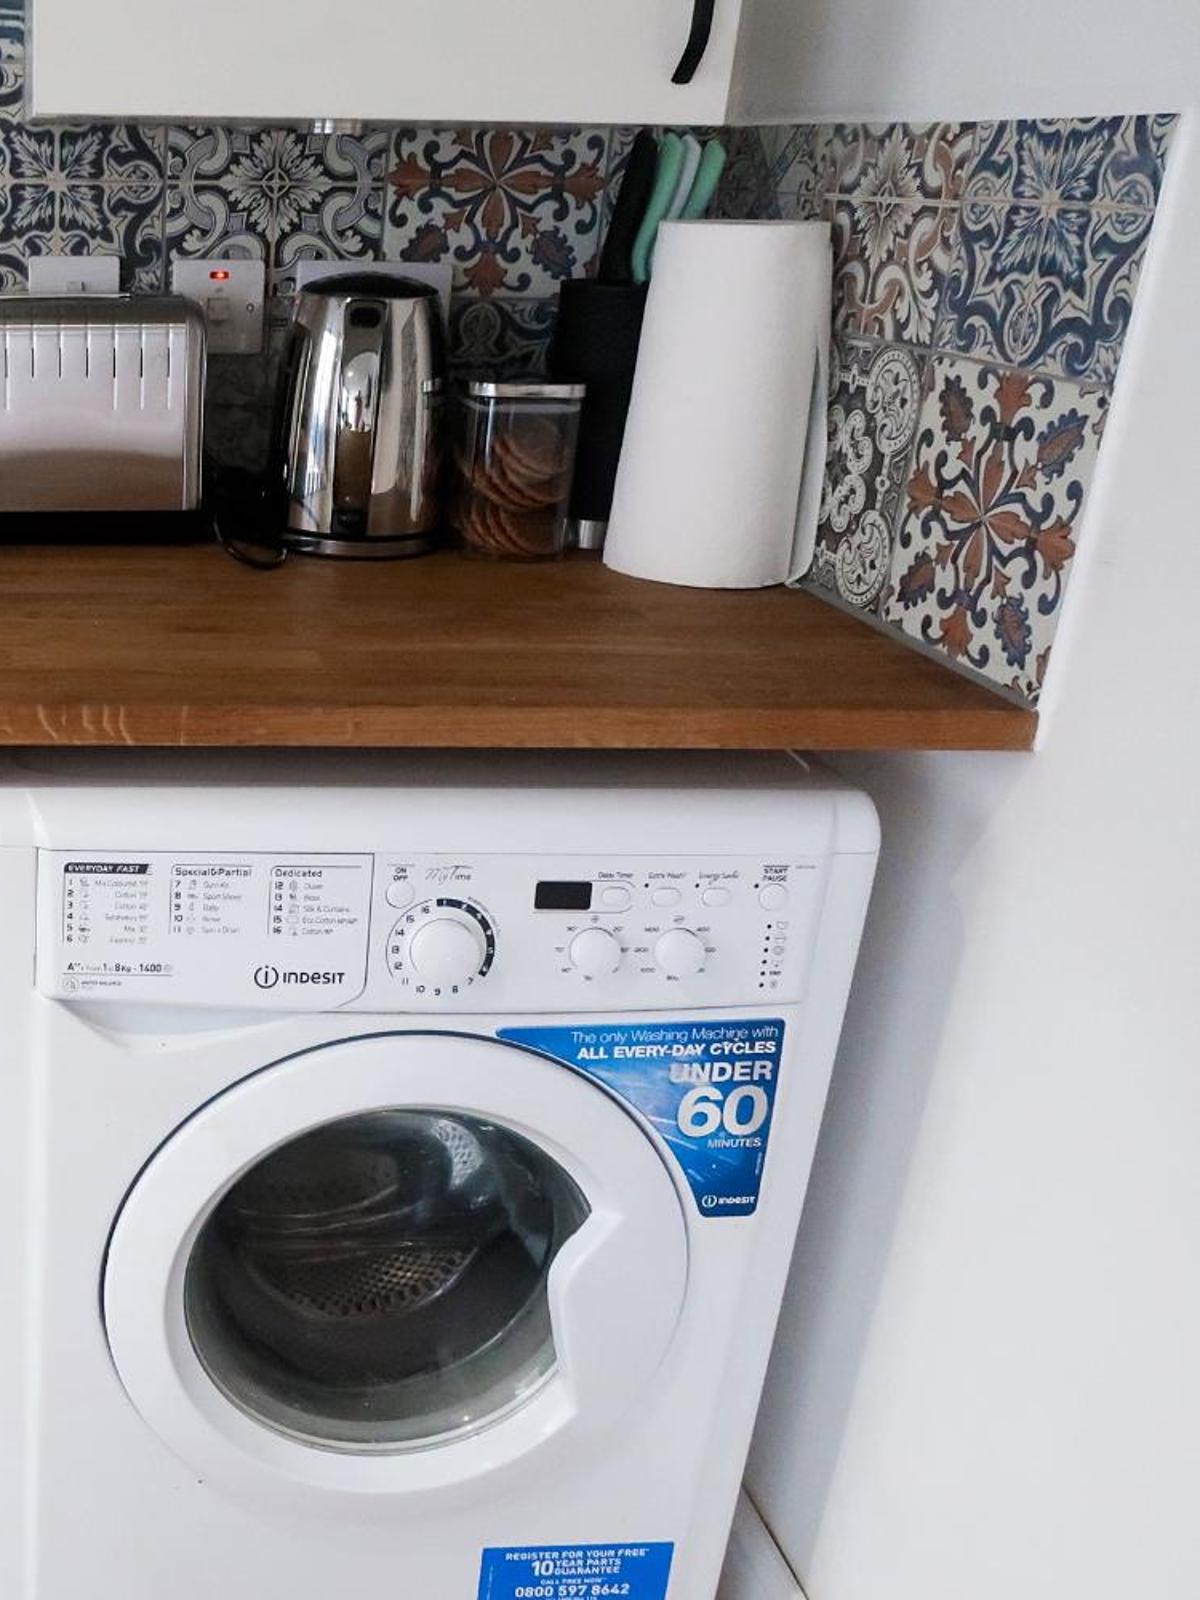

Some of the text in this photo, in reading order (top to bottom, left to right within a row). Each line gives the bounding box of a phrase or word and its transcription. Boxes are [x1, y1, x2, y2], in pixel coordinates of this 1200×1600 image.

[275, 868, 323, 877] Dedicated
[572, 1025, 779, 1045] The only Washing Machine with
[577, 1041, 777, 1060] ALL EVERY-DAY CYCLES
[669, 1060, 773, 1083] UNDER
[677, 1084, 768, 1138] 60
[707, 1137, 762, 1149] MINUTES
[505, 1552, 559, 1561] REGISTER
[560, 1550, 583, 1559] FOR
[586, 1549, 614, 1558] YOUR
[531, 1558, 622, 1577] 10 YEAR PARTS
[554, 1566, 621, 1576] GUARANTEE
[515, 1586, 553, 1598] 0800
[557, 1585, 587, 1597] 597
[591, 1583, 631, 1595] 8642
